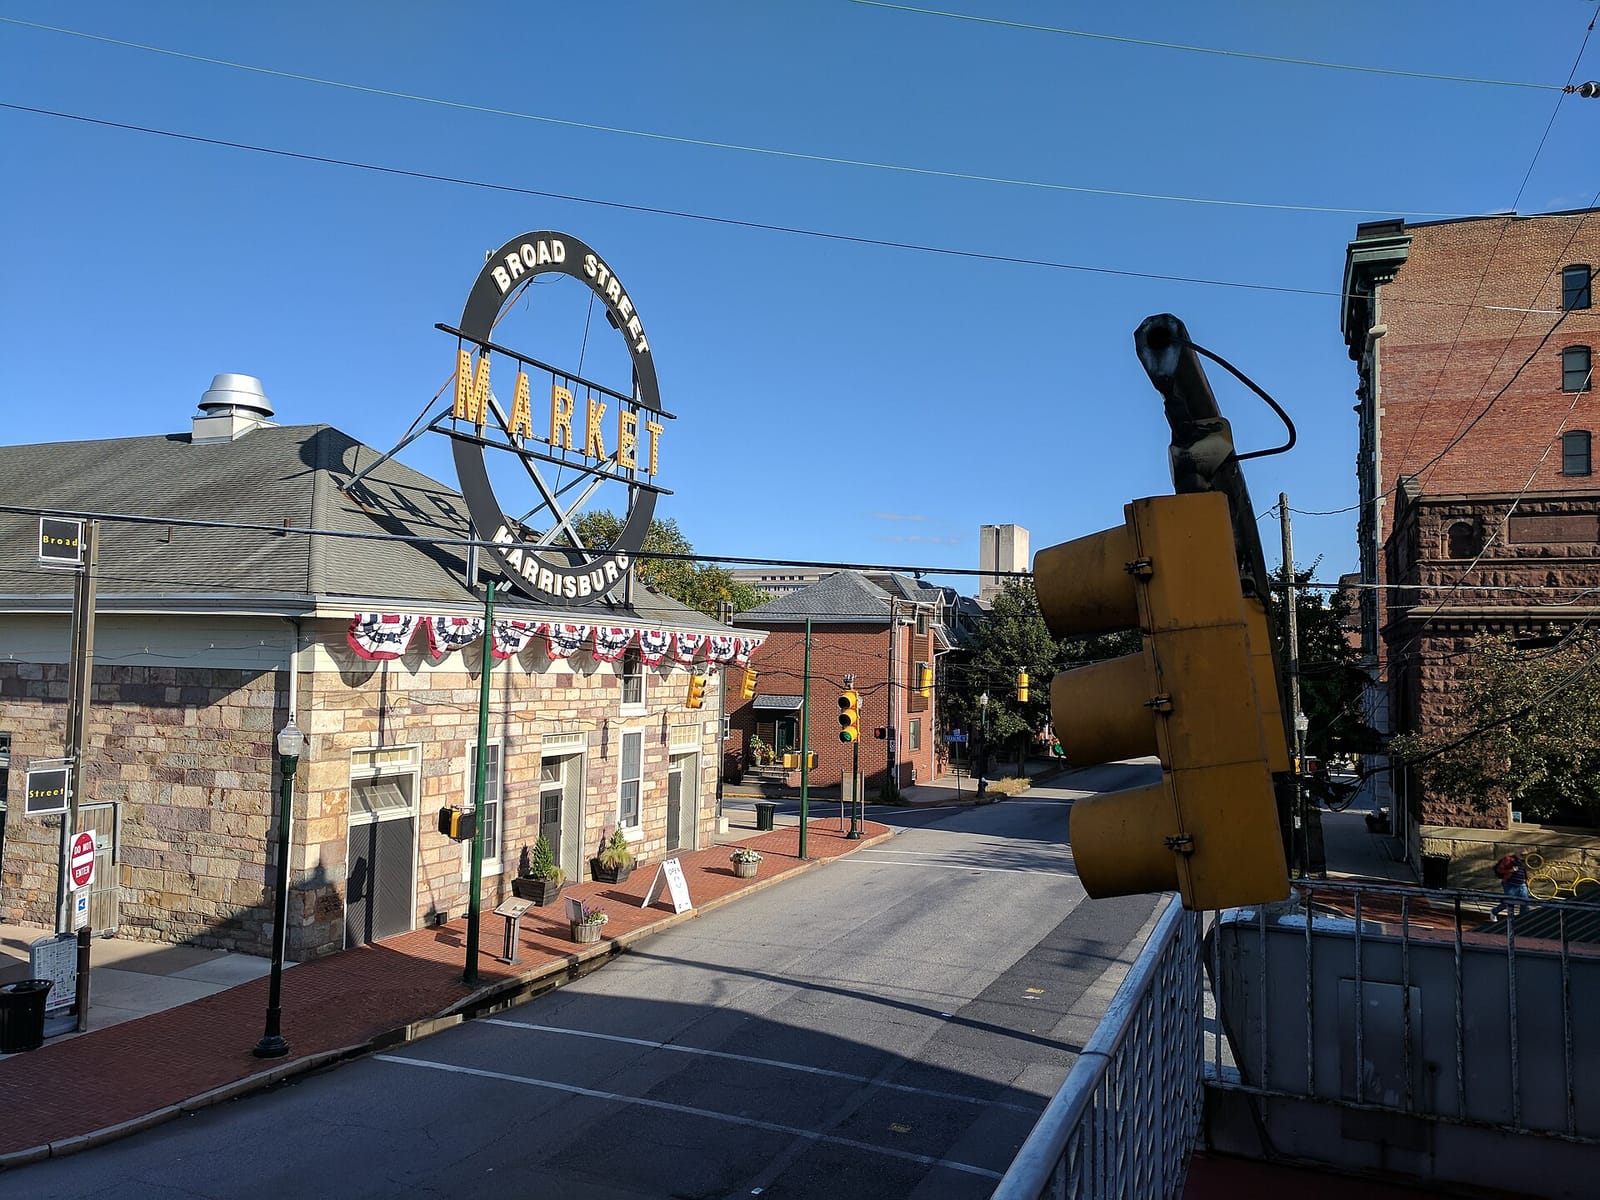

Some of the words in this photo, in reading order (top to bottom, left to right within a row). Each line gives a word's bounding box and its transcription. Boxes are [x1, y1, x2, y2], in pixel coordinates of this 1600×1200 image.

[491, 239, 566, 295] BROAD
[584, 253, 650, 354] STREET
[453, 349, 664, 476] MARKET
[42, 535, 79, 547] Broad
[492, 525, 630, 598] HARRISBURG
[29, 787, 64, 798] Street
[74, 845, 81, 855] DO
[82, 841, 92, 851] NOT
[76, 866, 90, 878] ENTER
